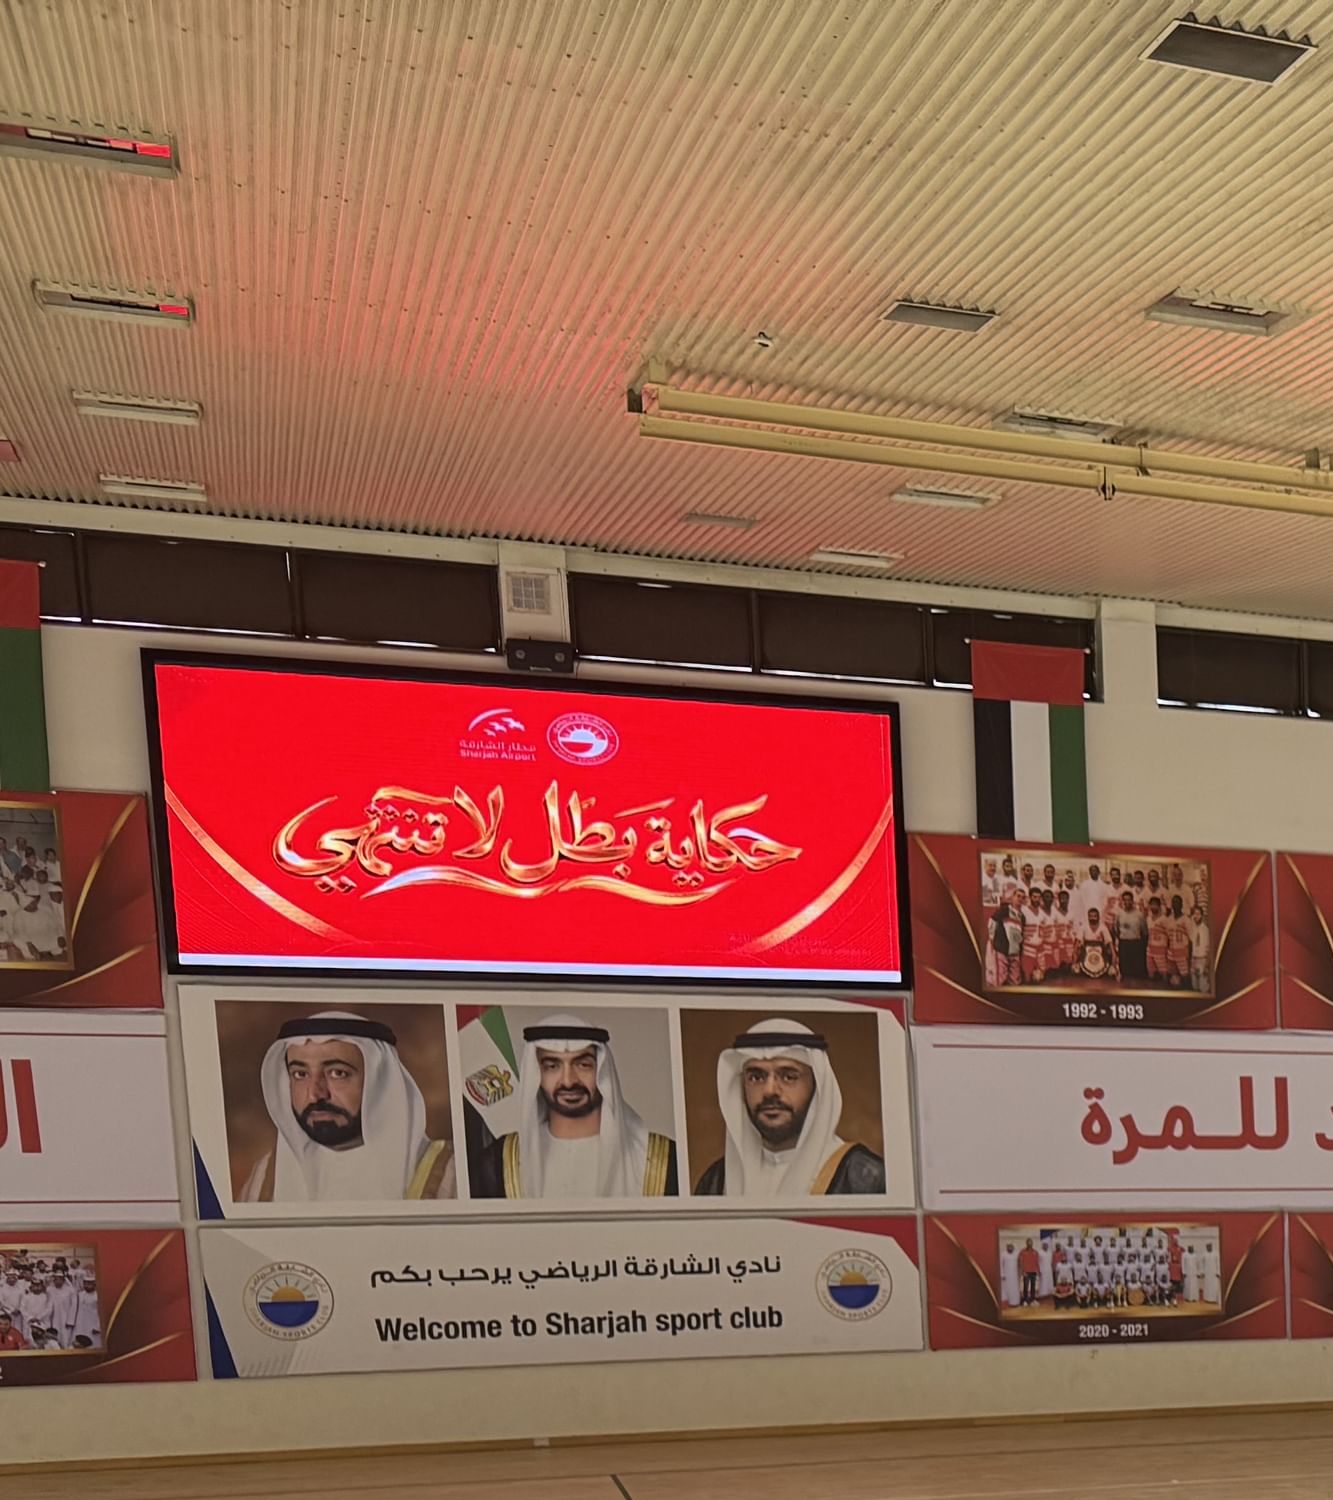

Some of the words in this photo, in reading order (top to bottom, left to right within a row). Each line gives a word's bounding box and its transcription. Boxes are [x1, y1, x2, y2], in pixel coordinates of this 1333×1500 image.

[460, 750, 499, 760] Sharjah
[501, 751, 537, 762] Airport
[452, 784, 504, 859] لا
[644, 793, 803, 888] حكاية
[1062, 1002, 1098, 1019] 1992
[1110, 1003, 1144, 1019] 1993
[1079, 1075, 1290, 1165] للمرة
[370, 1264, 433, 1288] بكم
[438, 1265, 513, 1287] يرحب
[518, 1259, 618, 1290] الرياضي
[624, 1253, 721, 1280] الشارقة
[726, 1255, 782, 1284] نادي
[375, 1314, 502, 1342] Welcome
[511, 1314, 537, 1337] to
[546, 1309, 648, 1339] Sharjah
[655, 1307, 723, 1335] sport
[730, 1305, 784, 1329] club
[1078, 1324, 1110, 1338] 2020
[1120, 1323, 1149, 1337] 2021
